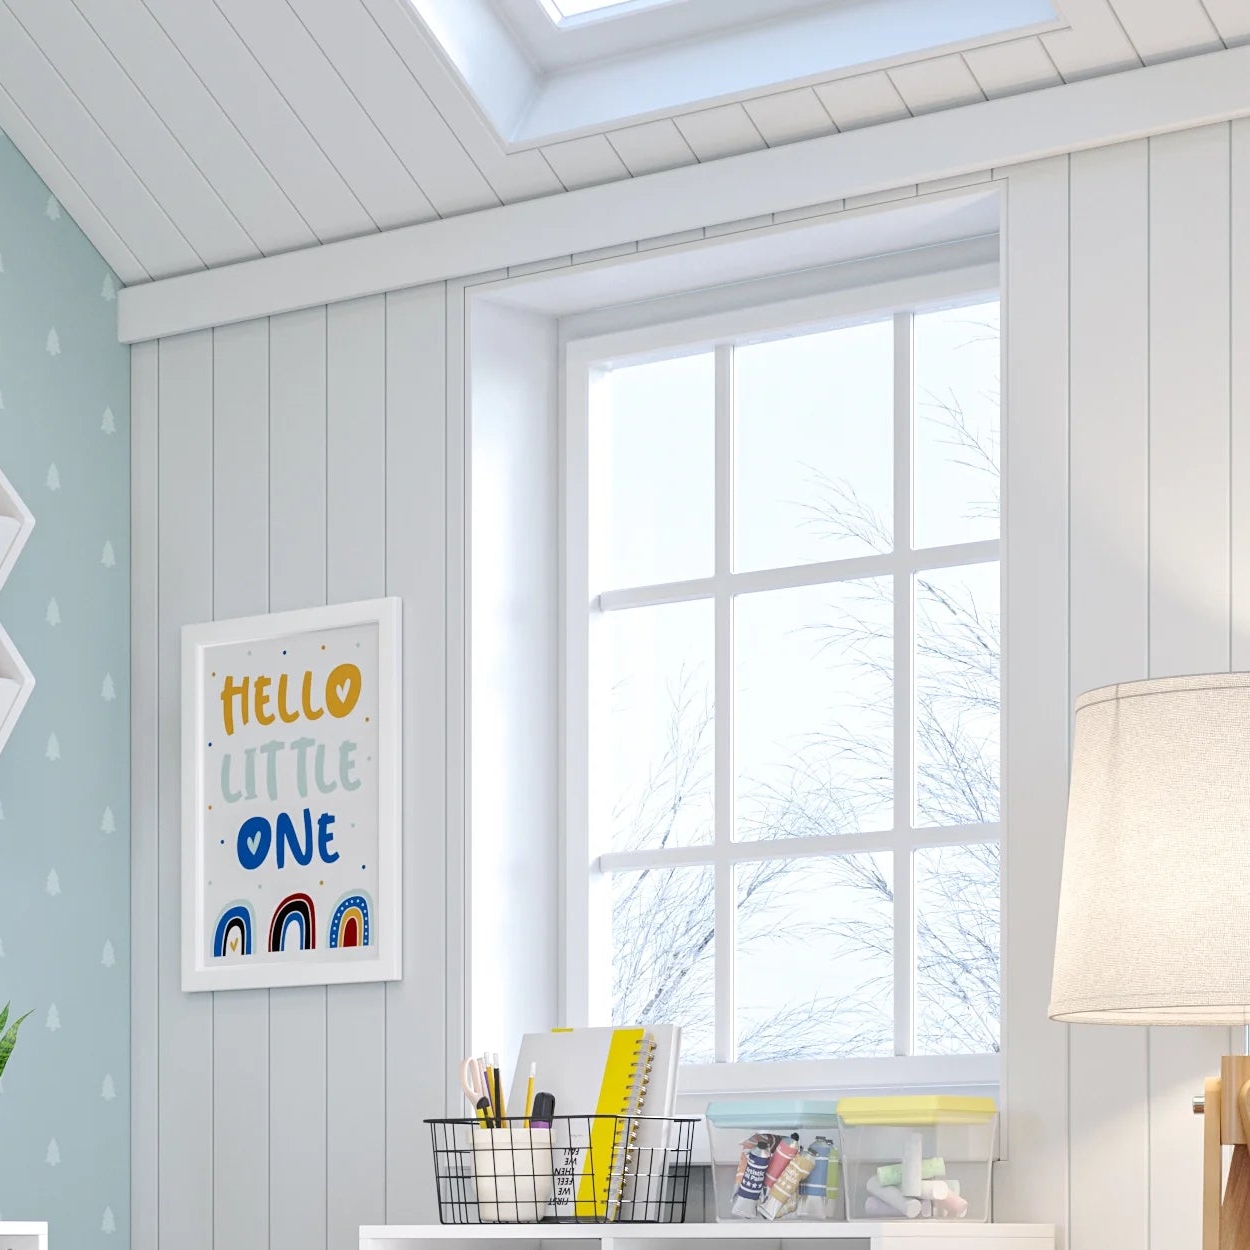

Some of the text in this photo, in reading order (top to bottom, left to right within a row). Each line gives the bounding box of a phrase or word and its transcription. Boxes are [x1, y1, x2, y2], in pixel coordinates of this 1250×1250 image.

[221, 663, 362, 735] HELLO
[221, 737, 362, 803] LITTLE
[236, 808, 340, 870] ONE
